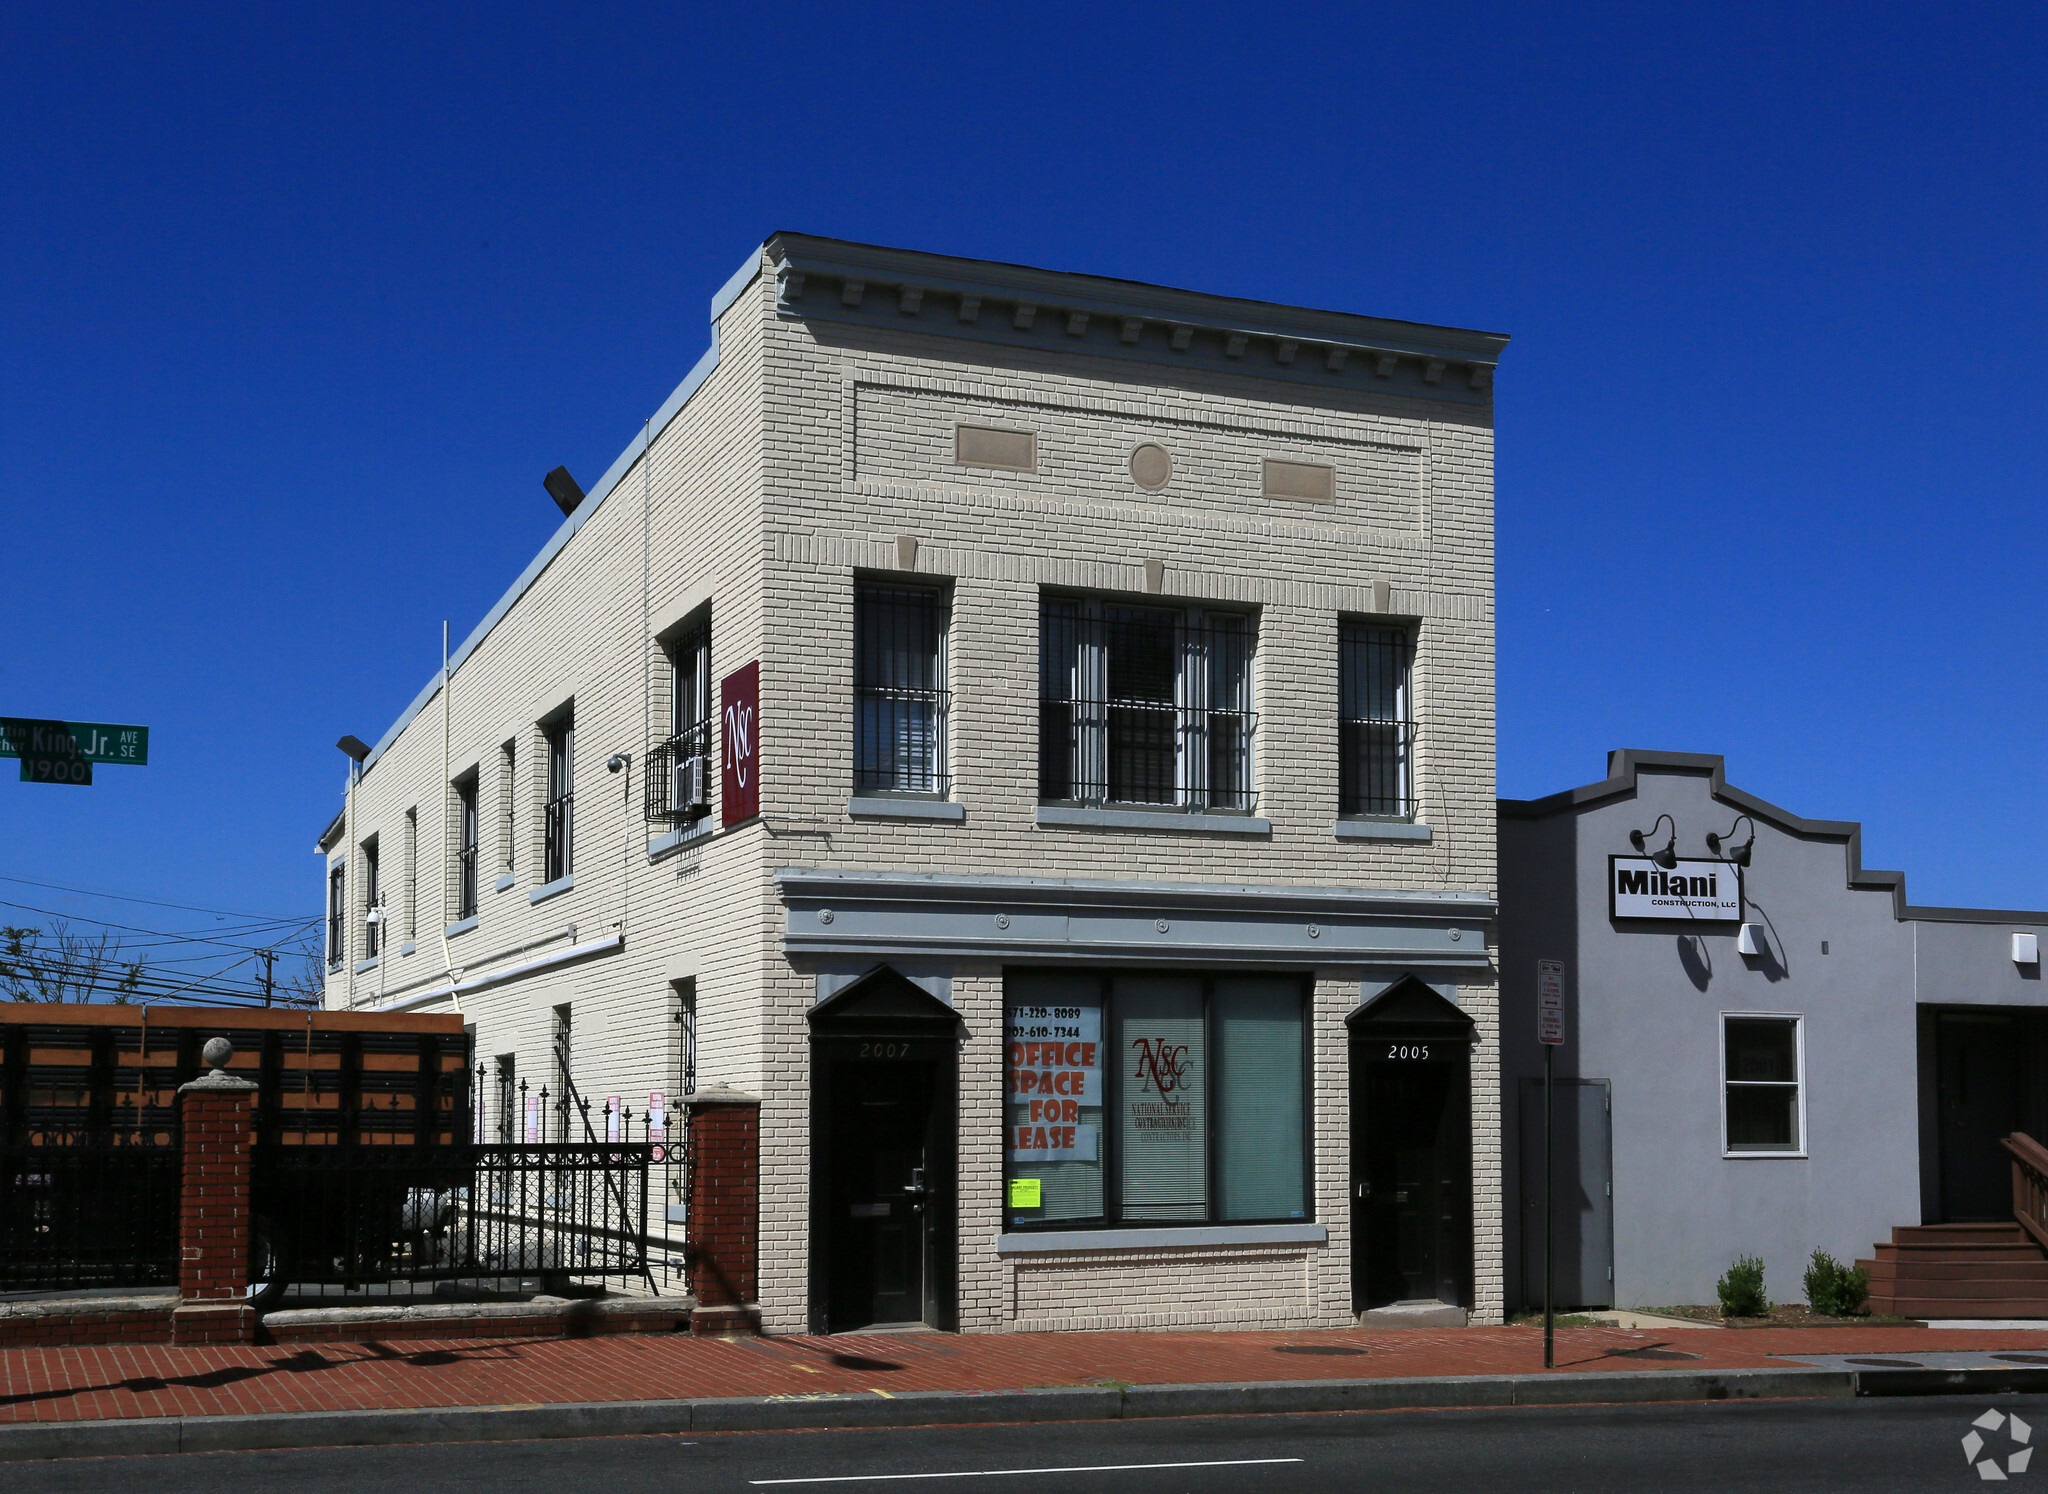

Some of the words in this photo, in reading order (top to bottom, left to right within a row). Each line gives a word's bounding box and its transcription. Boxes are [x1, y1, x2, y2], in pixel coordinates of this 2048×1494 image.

[84, 729, 115, 756] Jr.
[119, 731, 138, 744] AVE
[119, 744, 137, 758] SE
[27, 759, 87, 783] 1900
[1617, 869, 1717, 898] Milani
[860, 1042, 910, 1058] 2007
[1006, 1041, 1097, 1067] OFFICE
[1387, 1045, 1429, 1060] 2005
[1006, 1069, 1085, 1095] SPACE
[1029, 1098, 1078, 1123] FOR
[1004, 1125, 1076, 1150] LEASE
